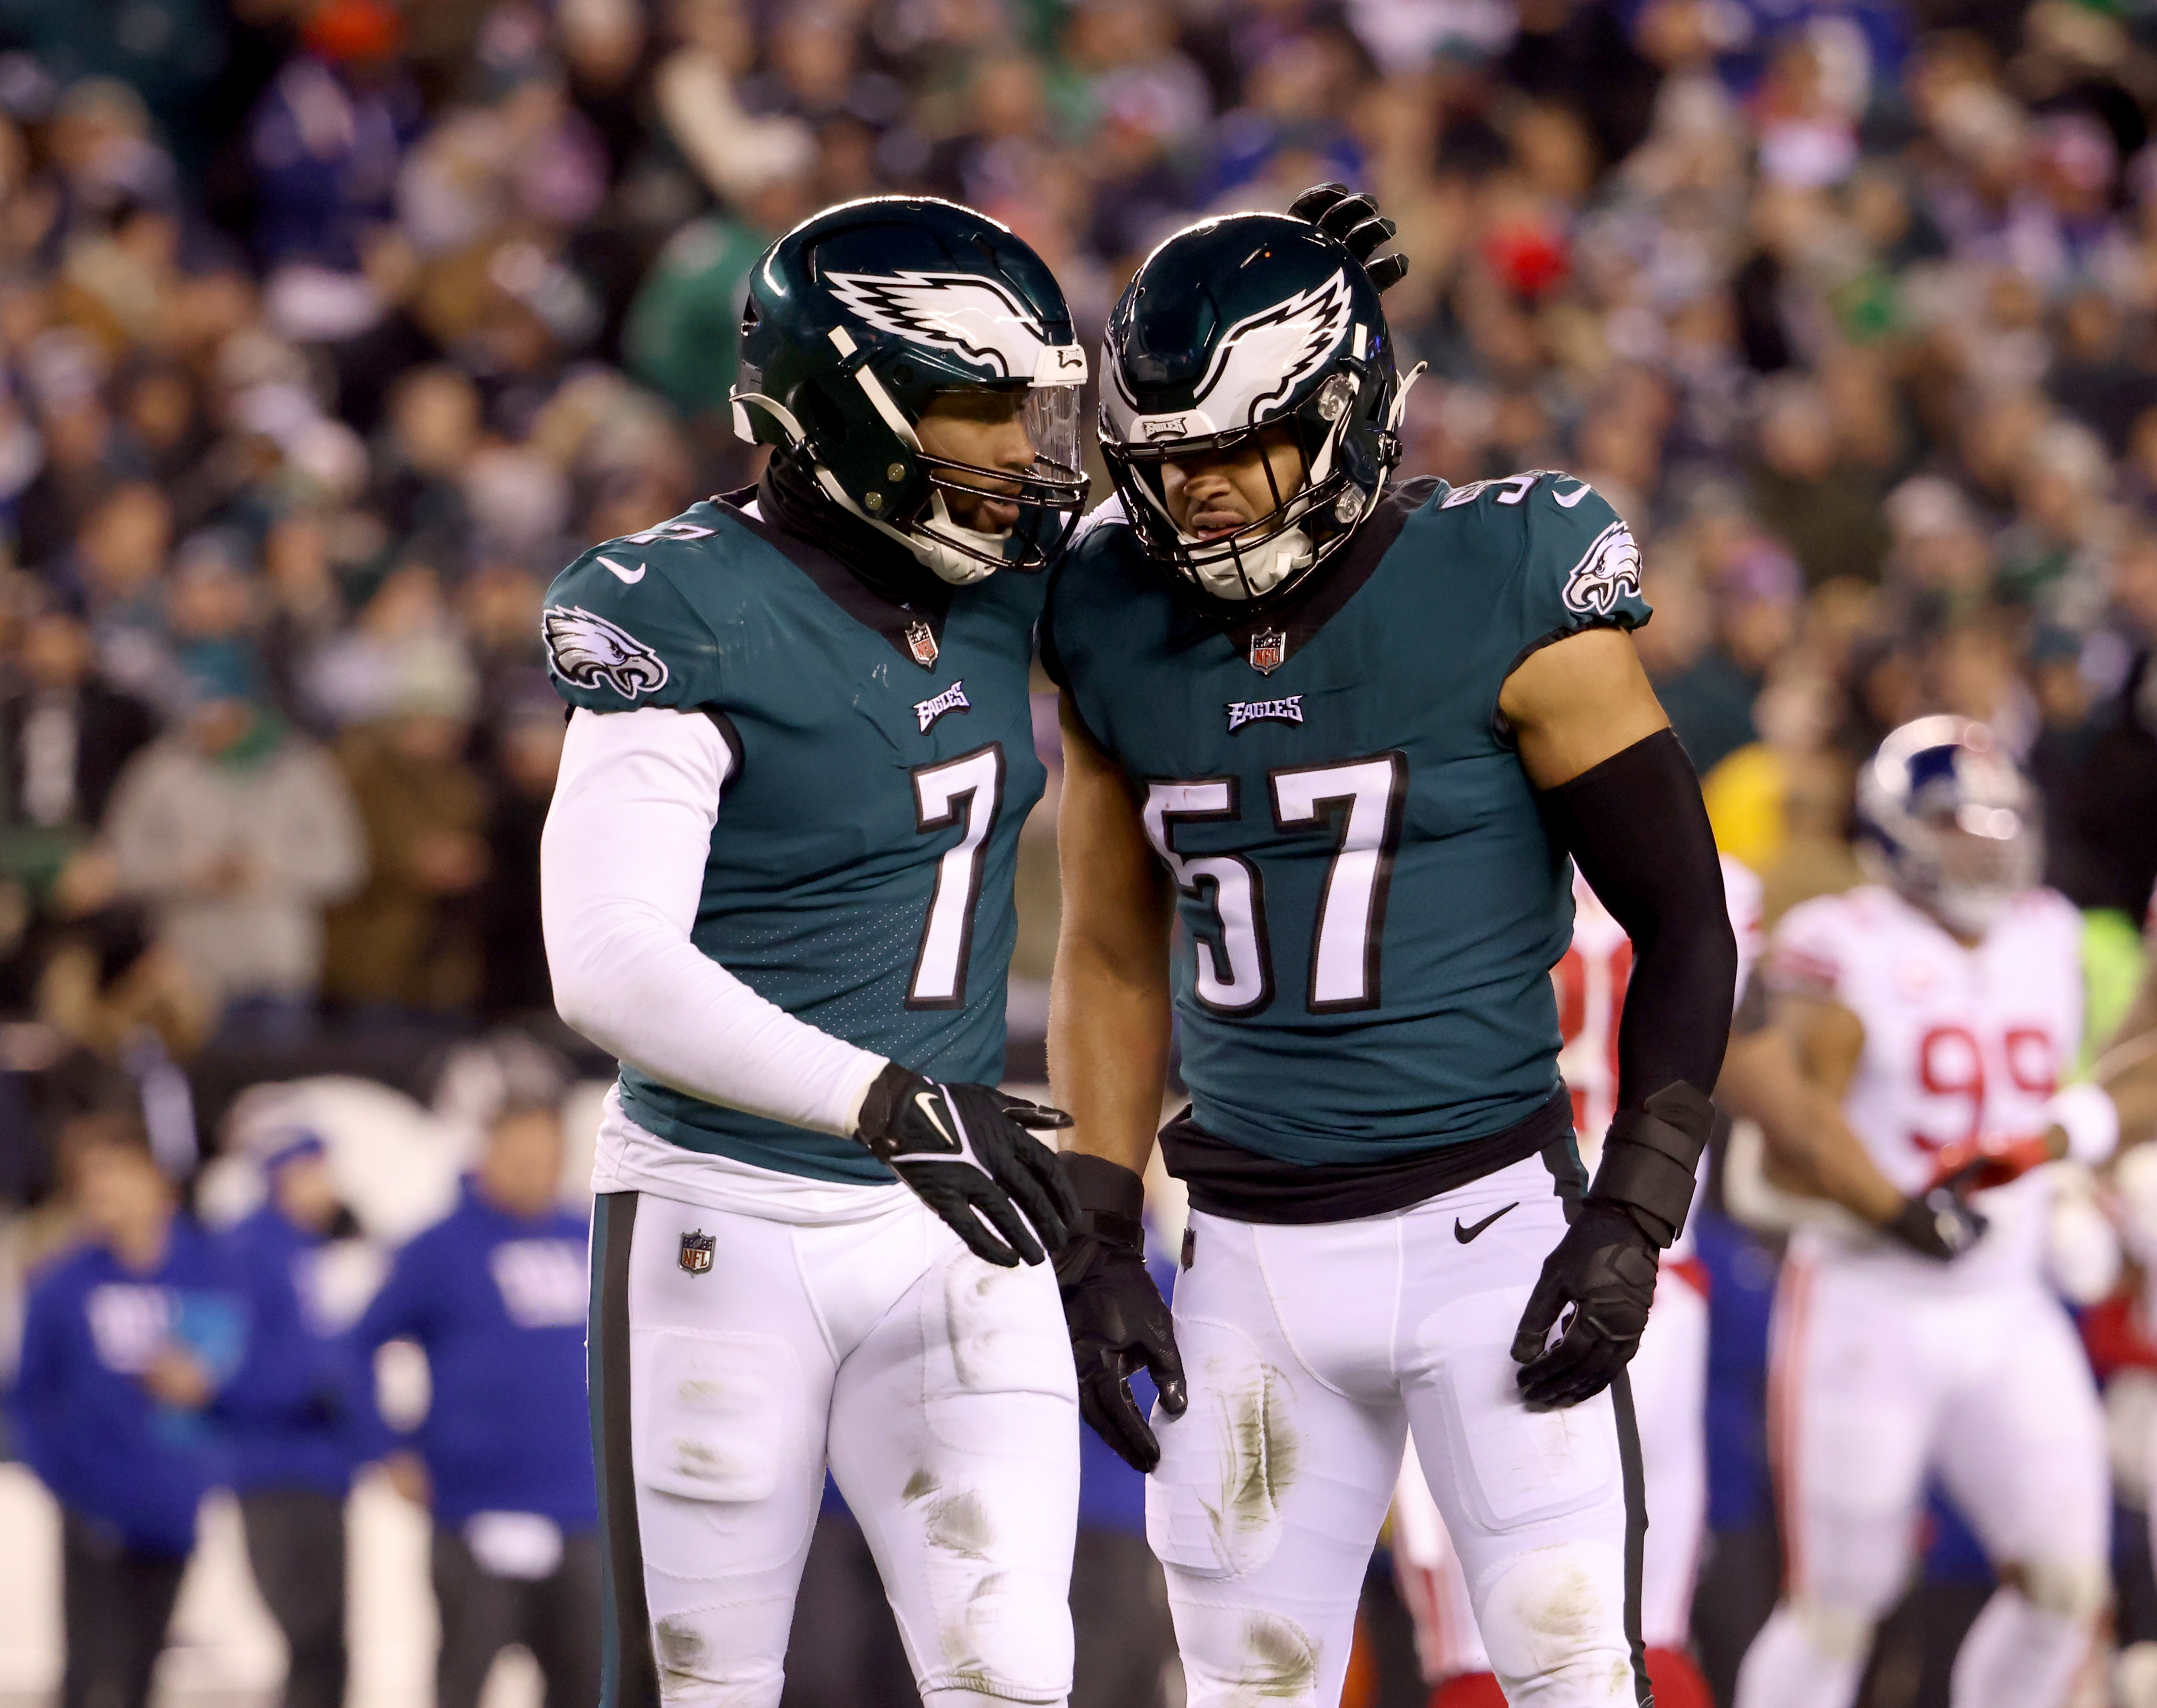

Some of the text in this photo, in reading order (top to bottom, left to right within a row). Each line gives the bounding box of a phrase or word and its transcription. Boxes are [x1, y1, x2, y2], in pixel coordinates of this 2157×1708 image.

[1256, 648, 1279, 666] NFL
[912, 680, 971, 734] EAGLES
[1227, 694, 1305, 732] EAGLES
[904, 741, 1006, 1010] 7
[1142, 750, 1408, 1017] 57
[682, 1249, 708, 1268] NFL
